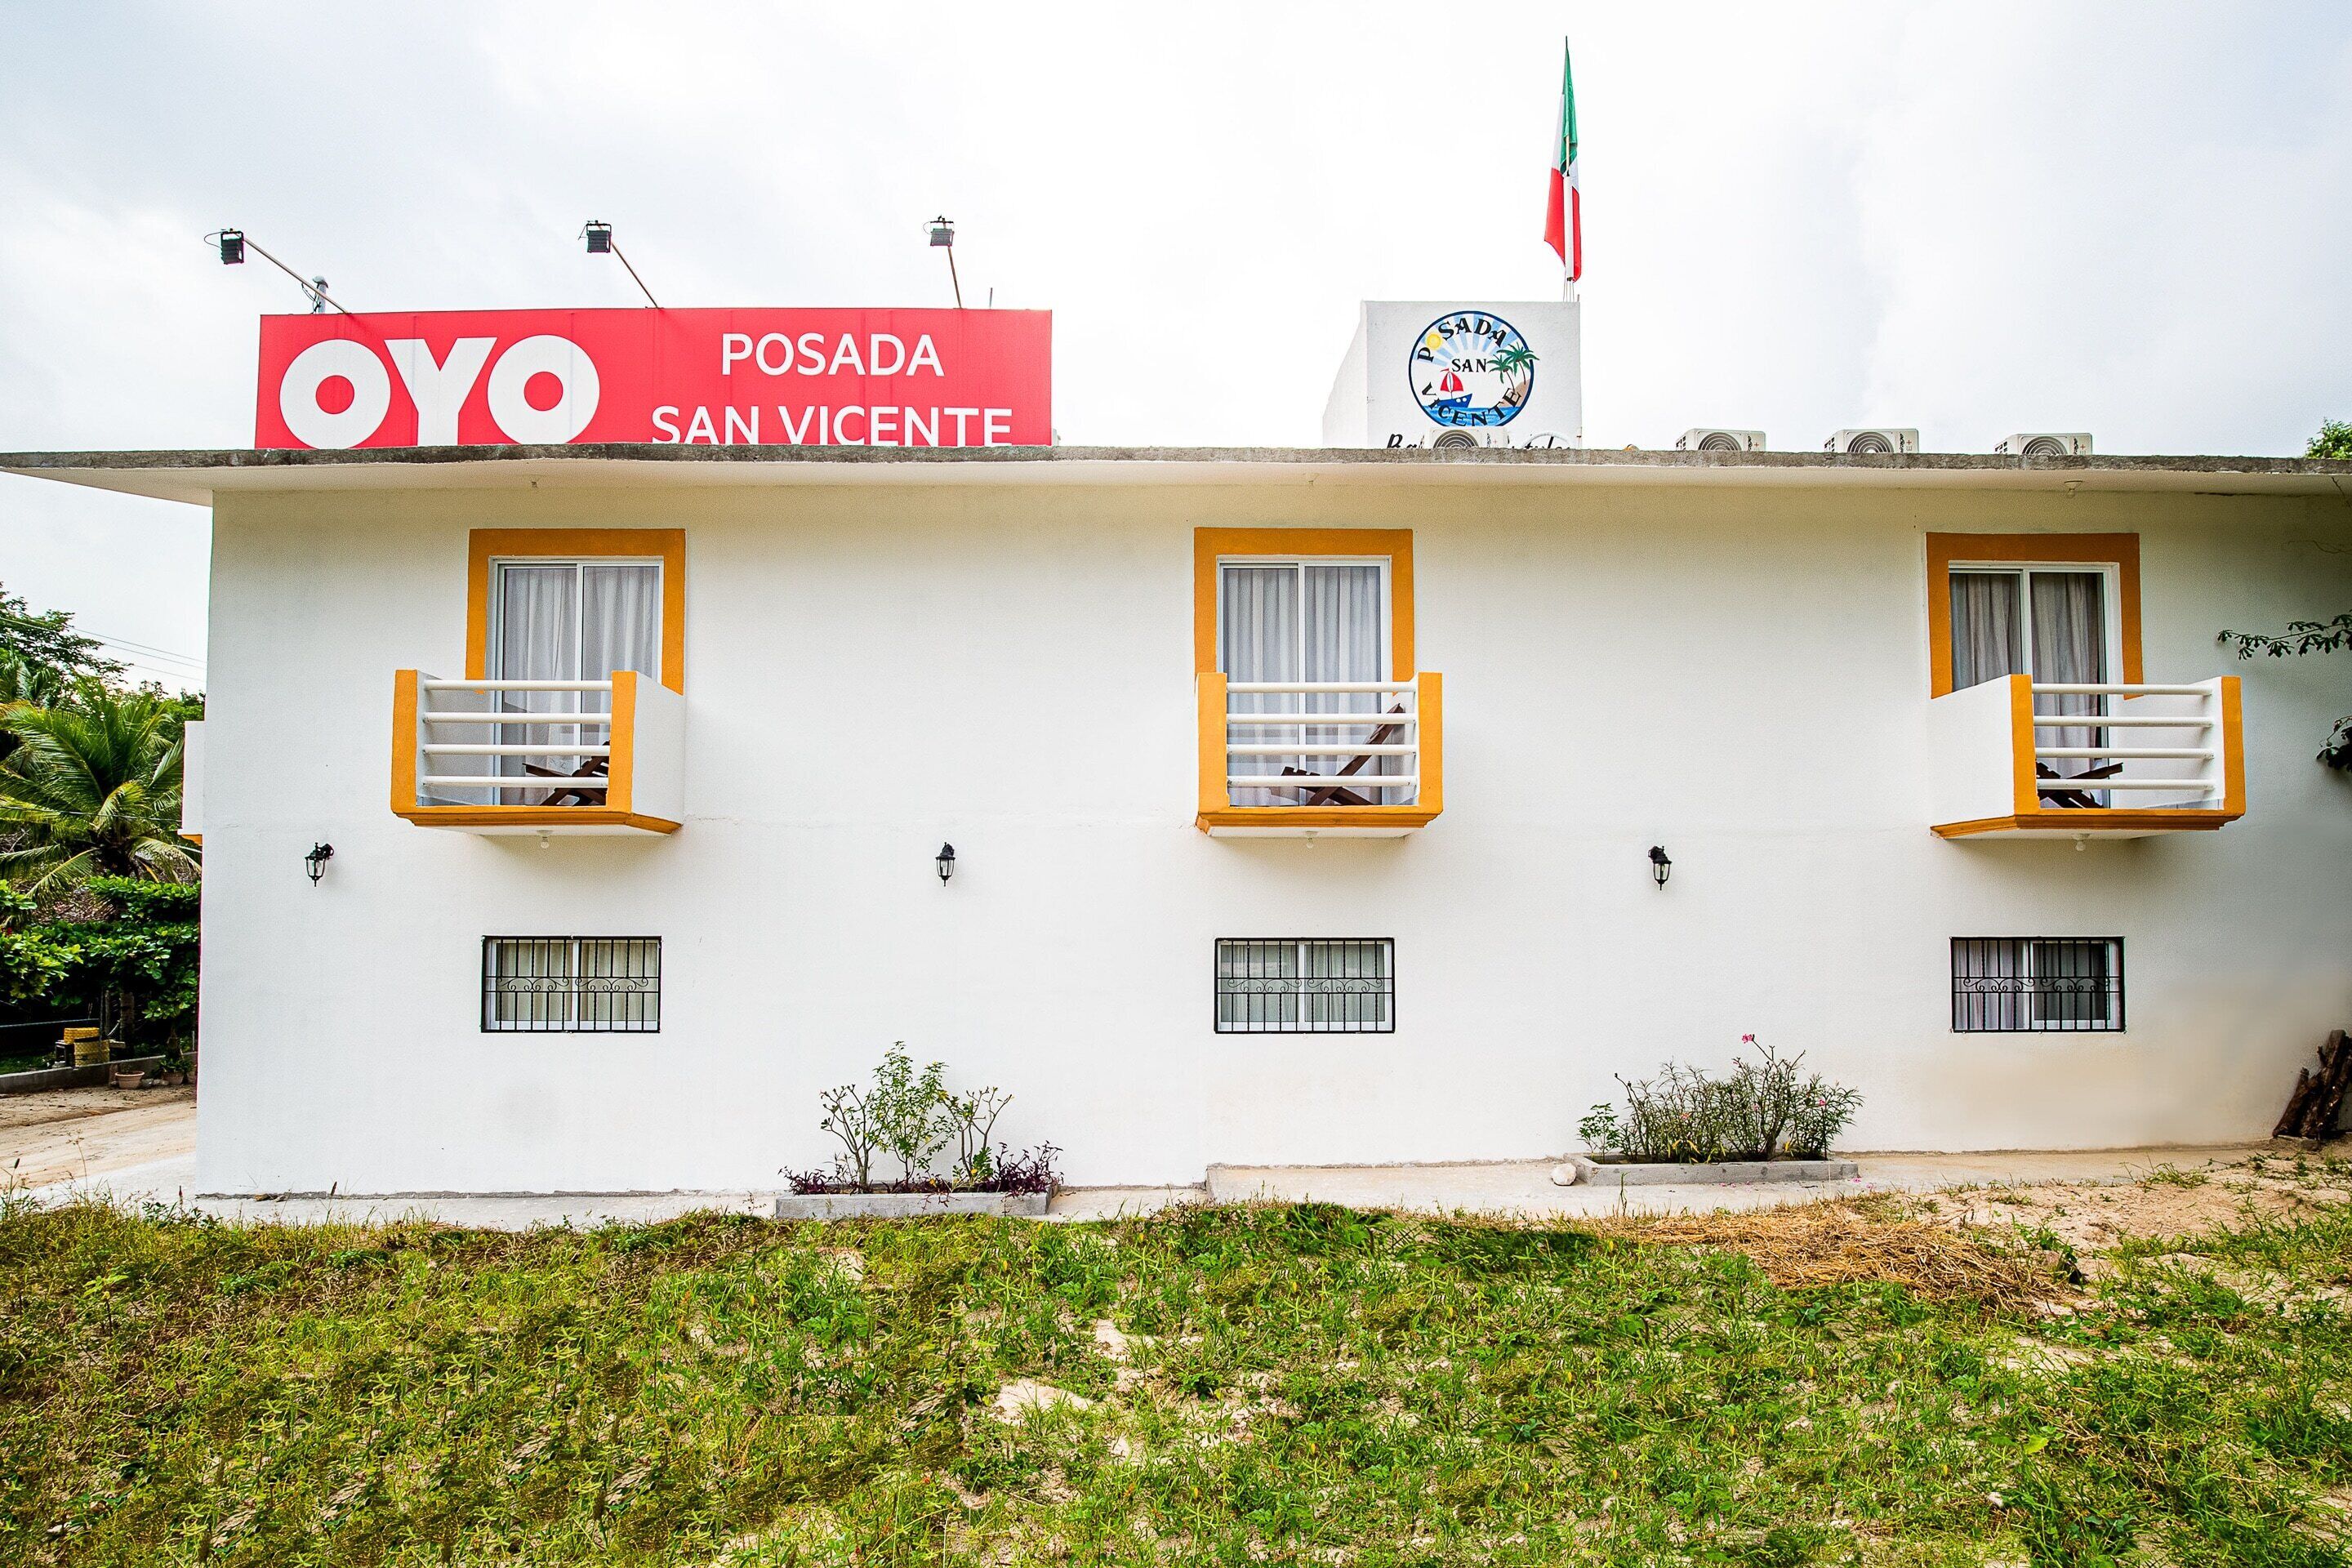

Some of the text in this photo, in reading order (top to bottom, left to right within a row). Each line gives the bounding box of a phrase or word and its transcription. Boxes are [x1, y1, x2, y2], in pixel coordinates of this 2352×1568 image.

[721, 332, 945, 376] POSADA
[1451, 359, 1487, 373] SAN
[278, 334, 600, 450] OYO
[1421, 382, 1522, 426] VICENTE
[651, 406, 1013, 447] SAN VICENTE
